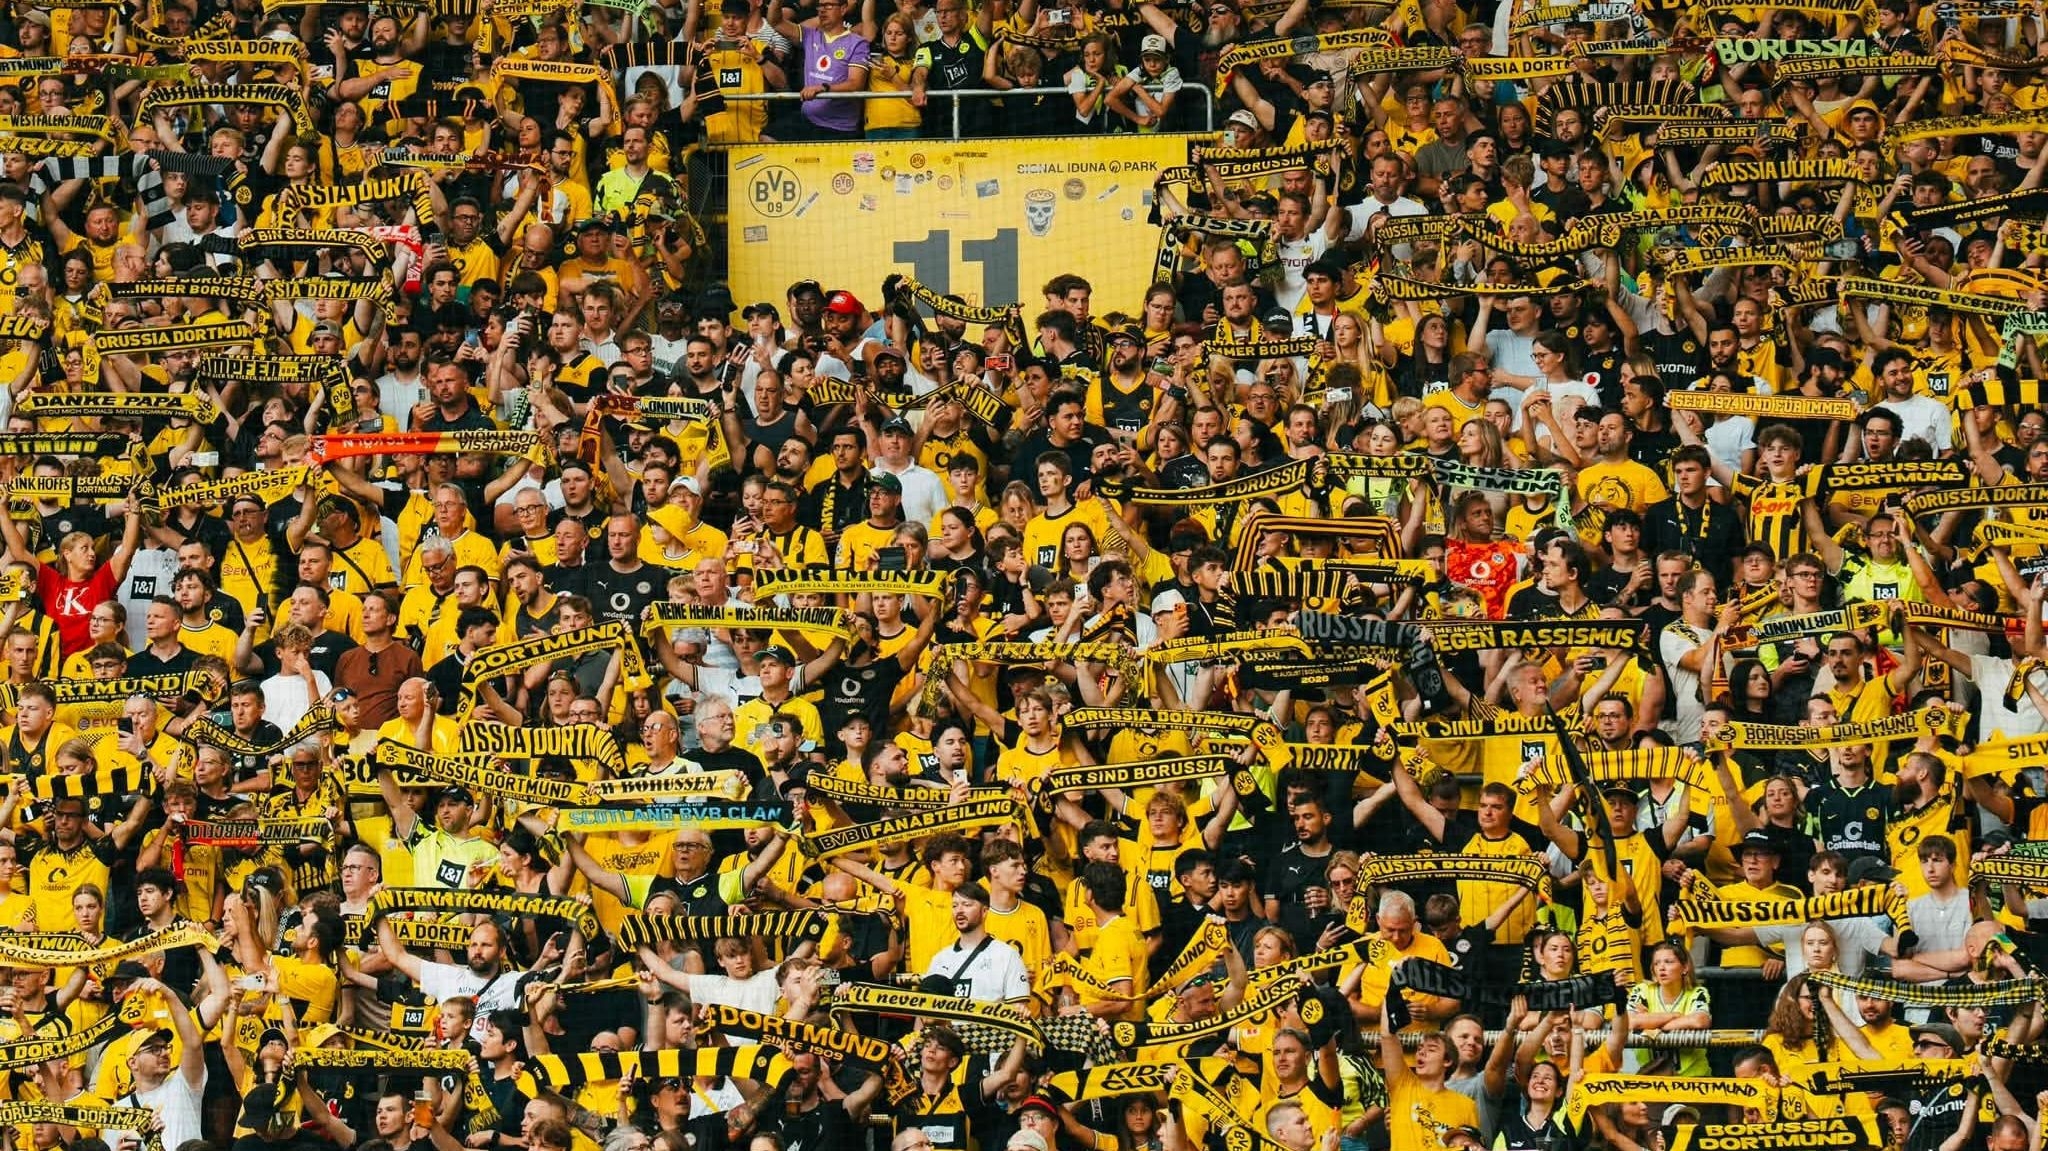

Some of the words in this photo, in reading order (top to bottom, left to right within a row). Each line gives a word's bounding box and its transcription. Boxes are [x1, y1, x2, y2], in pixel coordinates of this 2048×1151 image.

[1589, 40, 1658, 52] DORTMUND
[1716, 38, 1866, 65] BORUSSIA
[502, 62, 528, 72] CLUB
[531, 62, 570, 74] WORLD
[573, 65, 595, 75] CUP
[1219, 45, 1286, 82] DORTMUND
[1847, 55, 1936, 68] DORTMUND
[721, 72, 742, 83] 1&1
[946, 64, 966, 80] 1&1
[372, 85, 389, 96] 1&1
[11, 116, 104, 130] WESTFALENSTADION
[384, 152, 458, 162] DORTMUND
[1017, 164, 1064, 174] SIGNAL
[1067, 162, 1107, 173] IDUNA
[1124, 160, 1157, 172] PARK
[1163, 169, 1190, 180] WIR
[1233, 156, 1304, 174] BORUSSIA
[756, 170, 796, 201] BVB
[768, 202, 782, 213] 09
[1912, 198, 1969, 218] BORUSSIA
[1955, 211, 1971, 219] AS
[1973, 204, 2008, 217] ROMA
[260, 230, 291, 242] BIN
[295, 229, 384, 259] SCHWARZGELB
[894, 229, 1018, 319] 11
[1790, 284, 1828, 300] SIND
[1655, 363, 1697, 374] EVONIK
[1928, 378, 1947, 391] 1&1
[32, 395, 118, 407] DANKE
[128, 396, 183, 407] PAPA
[1675, 394, 1703, 408] SEIT
[1707, 394, 1739, 410] 1974
[1743, 396, 1772, 412] UND
[1775, 398, 1801, 414] FÜR
[1804, 401, 1850, 416] IMMER
[1224, 463, 1307, 493] BORUSSIA
[1833, 462, 1960, 475] BORUSSIA
[76, 486, 121, 494] DORTMUND
[1828, 473, 1965, 487] DORTMUND
[1752, 500, 1792, 515] e-on
[1907, 488, 1989, 510] BORUSSIA
[134, 579, 155, 594] 1&1
[756, 570, 937, 585] DORTMUND
[1875, 586, 1897, 599] 1&1
[656, 602, 687, 620] MEINE
[734, 606, 835, 627] WESTFALENSTADION
[1910, 604, 1997, 624] DORTMUND
[1762, 611, 1843, 638] DORTMUND
[1166, 634, 1209, 649] VEREIN.
[1226, 629, 1262, 641] MEINE
[1502, 625, 1635, 649] RASSISMUS
[470, 624, 622, 673] DORTMUND
[1064, 708, 1152, 728] BORUSSIA
[1157, 711, 1254, 730] DORTMUND
[1393, 722, 1428, 738] WIR
[1440, 721, 1484, 737] SIND
[1495, 715, 1587, 734] BORUSSIA
[1746, 727, 1822, 742] BORUSSIA
[1831, 716, 1917, 738] DORTMUND
[1523, 745, 1545, 757] 1&1
[407, 752, 480, 784] BORUSSIA
[484, 771, 572, 799] DORTMUND
[1052, 773, 1084, 789] WIR
[1086, 769, 1129, 783] SIND
[1132, 759, 1226, 780] BORUSSIA
[623, 776, 718, 793] BORUSSEN
[809, 775, 899, 800] BORUSSIA
[570, 809, 672, 826] SCOTLAND
[680, 808, 722, 822] BVB
[728, 806, 782, 820] CLAN
[820, 830, 859, 850] BVB
[871, 802, 1011, 837] FANABTEILUNG
[439, 866, 462, 881] 1&1
[1443, 859, 1541, 879] DORTMUND
[876, 994, 926, 1009] never
[931, 996, 976, 1012] walk
[404, 1011, 422, 1023] 1&1
[1150, 1023, 1184, 1039] WIR
[1186, 1012, 1223, 1034] SIND
[719, 1006, 890, 1062] DORTMUND
[762, 1034, 802, 1051] SINCE
[809, 1046, 844, 1061] 1909
[1105, 1063, 1177, 1079] KIDS
[1584, 1077, 1667, 1095] BORUSSIA
[1679, 1080, 1757, 1097] DORTMUND
[78, 1107, 153, 1134] DORTMUND
[1705, 1119, 1848, 1137] BORUSSIA
[1699, 1131, 1856, 1151] DORTMUND
